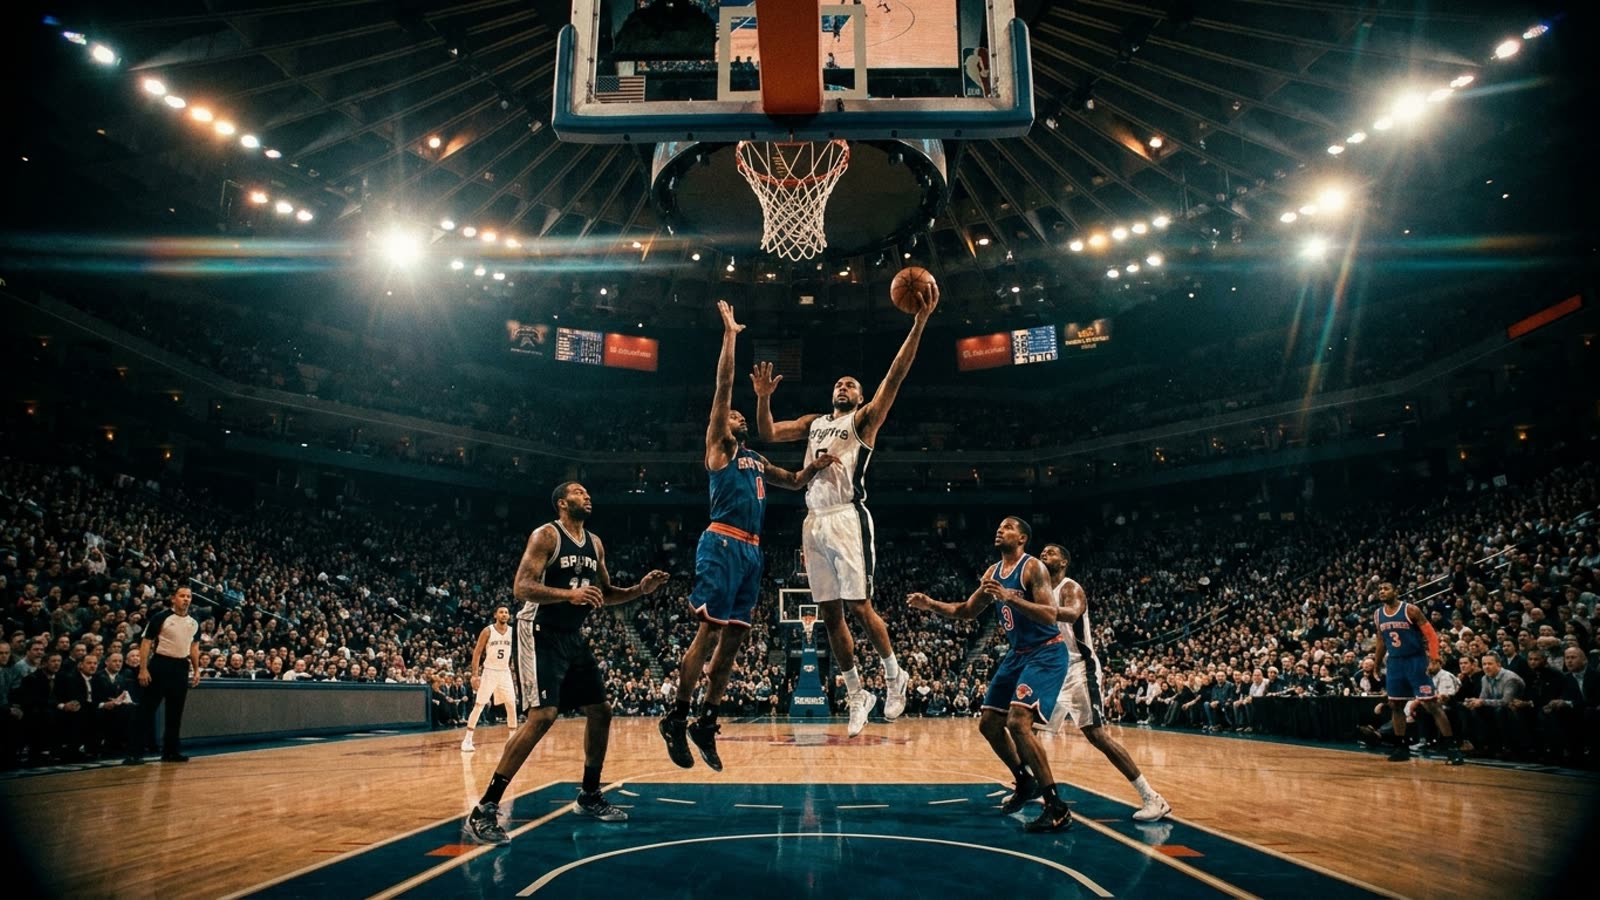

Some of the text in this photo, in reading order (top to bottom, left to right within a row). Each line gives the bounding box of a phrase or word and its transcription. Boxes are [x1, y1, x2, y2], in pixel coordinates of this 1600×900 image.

[1001, 605, 1015, 631] 3
[1389, 631, 1402, 648] 3
[497, 649, 505, 660] 5
